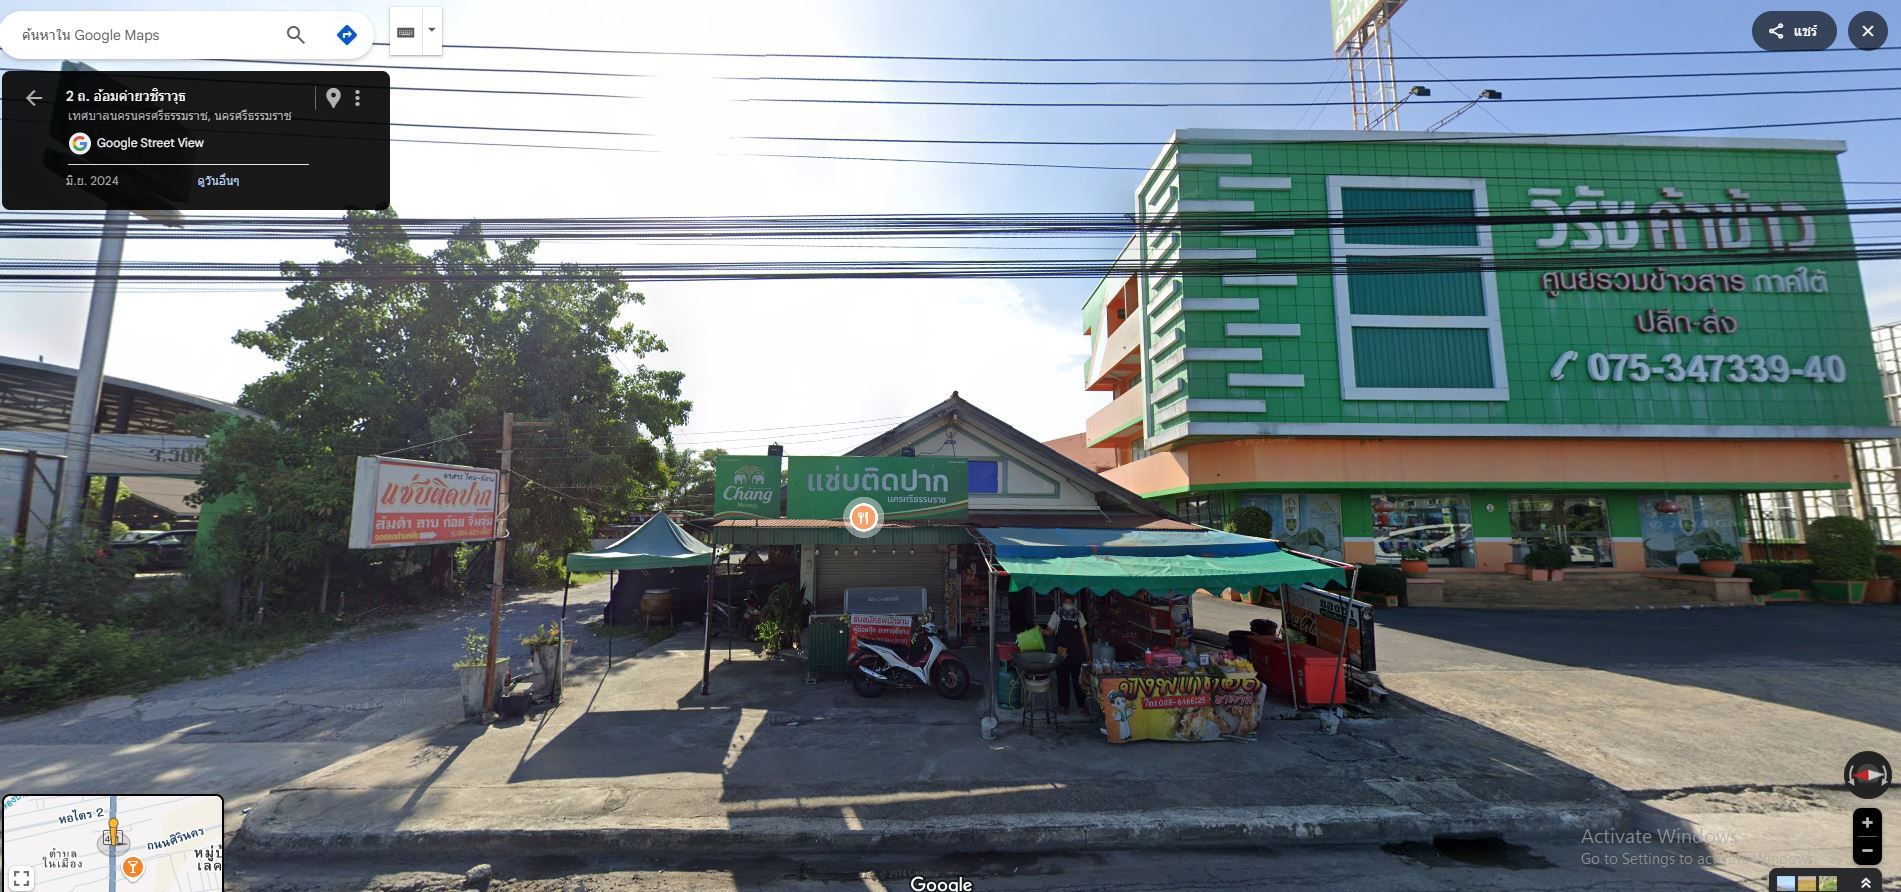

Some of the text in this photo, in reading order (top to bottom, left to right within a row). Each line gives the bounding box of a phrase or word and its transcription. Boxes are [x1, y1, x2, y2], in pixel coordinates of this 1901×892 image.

[1648, 186, 1817, 251] ค้าข้าว
[1541, 266, 1829, 298] ศูนย์รวมข้าวสาร ภาคใต้
[1635, 307, 1739, 335] ปลีก-ส่ง
[1587, 352, 1847, 383] 075-347339-40
[807, 464, 949, 493] แซ่บติดปาก
[722, 485, 774, 504] Chang
[887, 493, 947, 504] นครศรีธรรมราช
[375, 515, 412, 530] ส้มตำ
[416, 517, 440, 529] ลาบ
